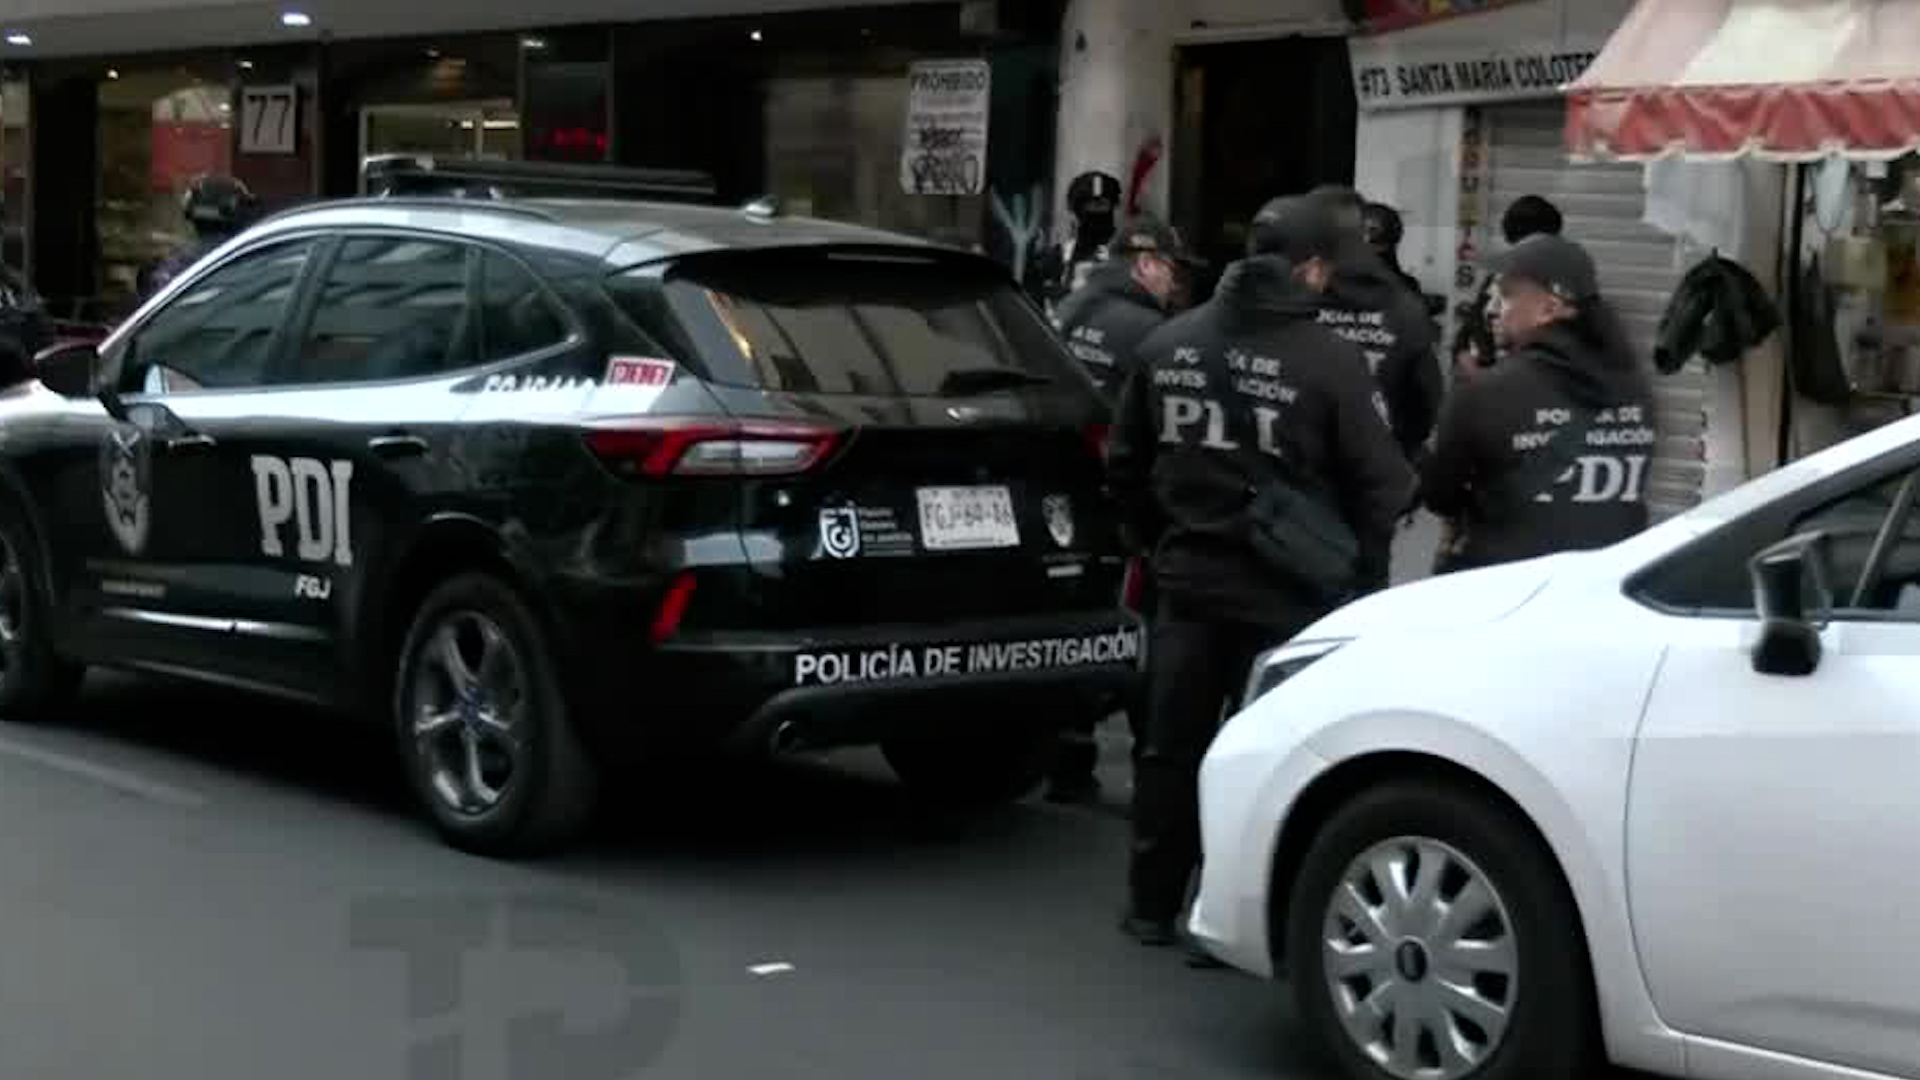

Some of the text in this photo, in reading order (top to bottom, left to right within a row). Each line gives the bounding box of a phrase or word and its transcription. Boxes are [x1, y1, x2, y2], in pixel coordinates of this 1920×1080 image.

[1397, 62, 1454, 96] SANTA
[247, 95, 291, 145] 77
[1251, 357, 1281, 377] DE
[251, 454, 354, 568] PDI
[295, 574, 332, 600] FGJ
[795, 624, 1139, 684] POLICÍA DE INVESTIGACIÓN
